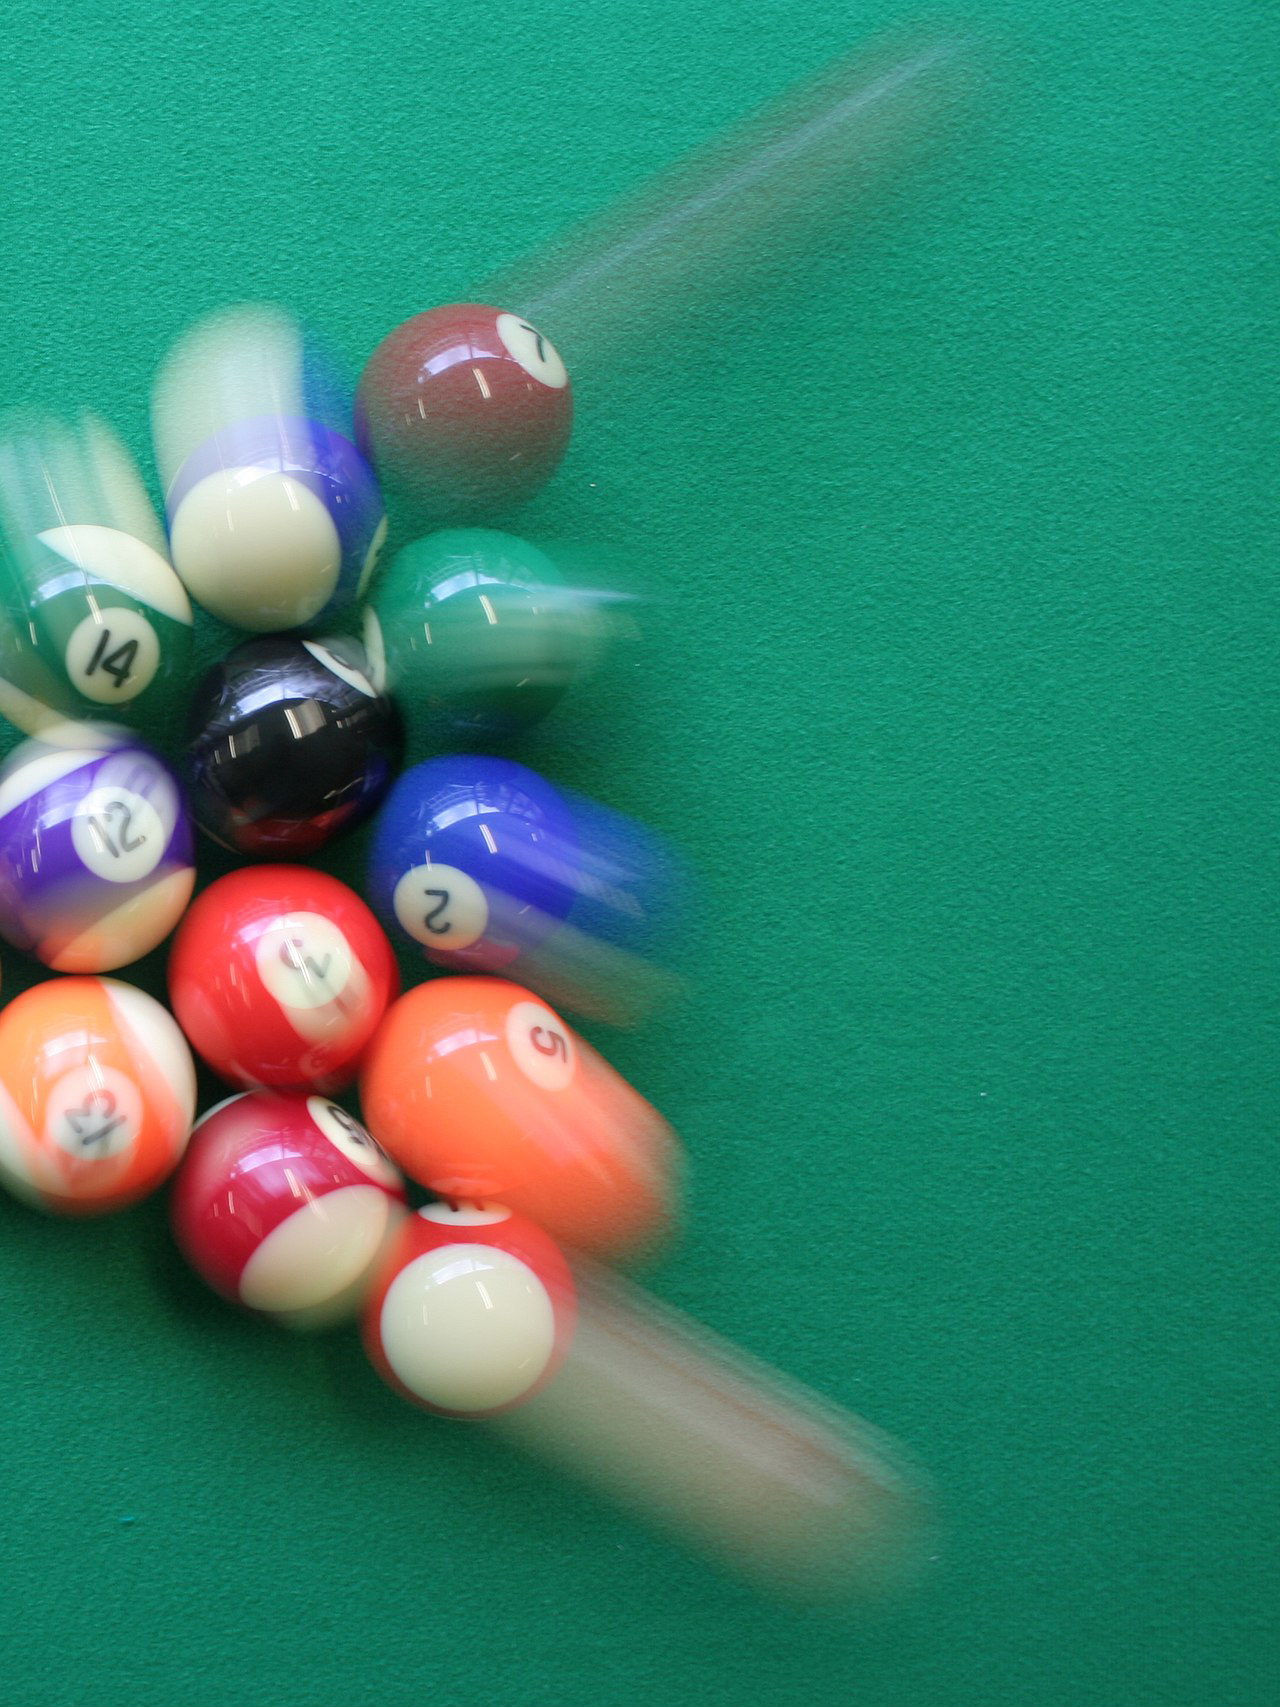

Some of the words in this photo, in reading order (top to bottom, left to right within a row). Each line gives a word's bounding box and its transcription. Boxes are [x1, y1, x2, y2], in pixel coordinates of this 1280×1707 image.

[519, 324, 545, 363] 7
[86, 629, 138, 688] 14
[88, 801, 146, 858] 12
[424, 889, 450, 934] 2
[530, 1026, 567, 1064] 5
[64, 1088, 127, 1146] 13
